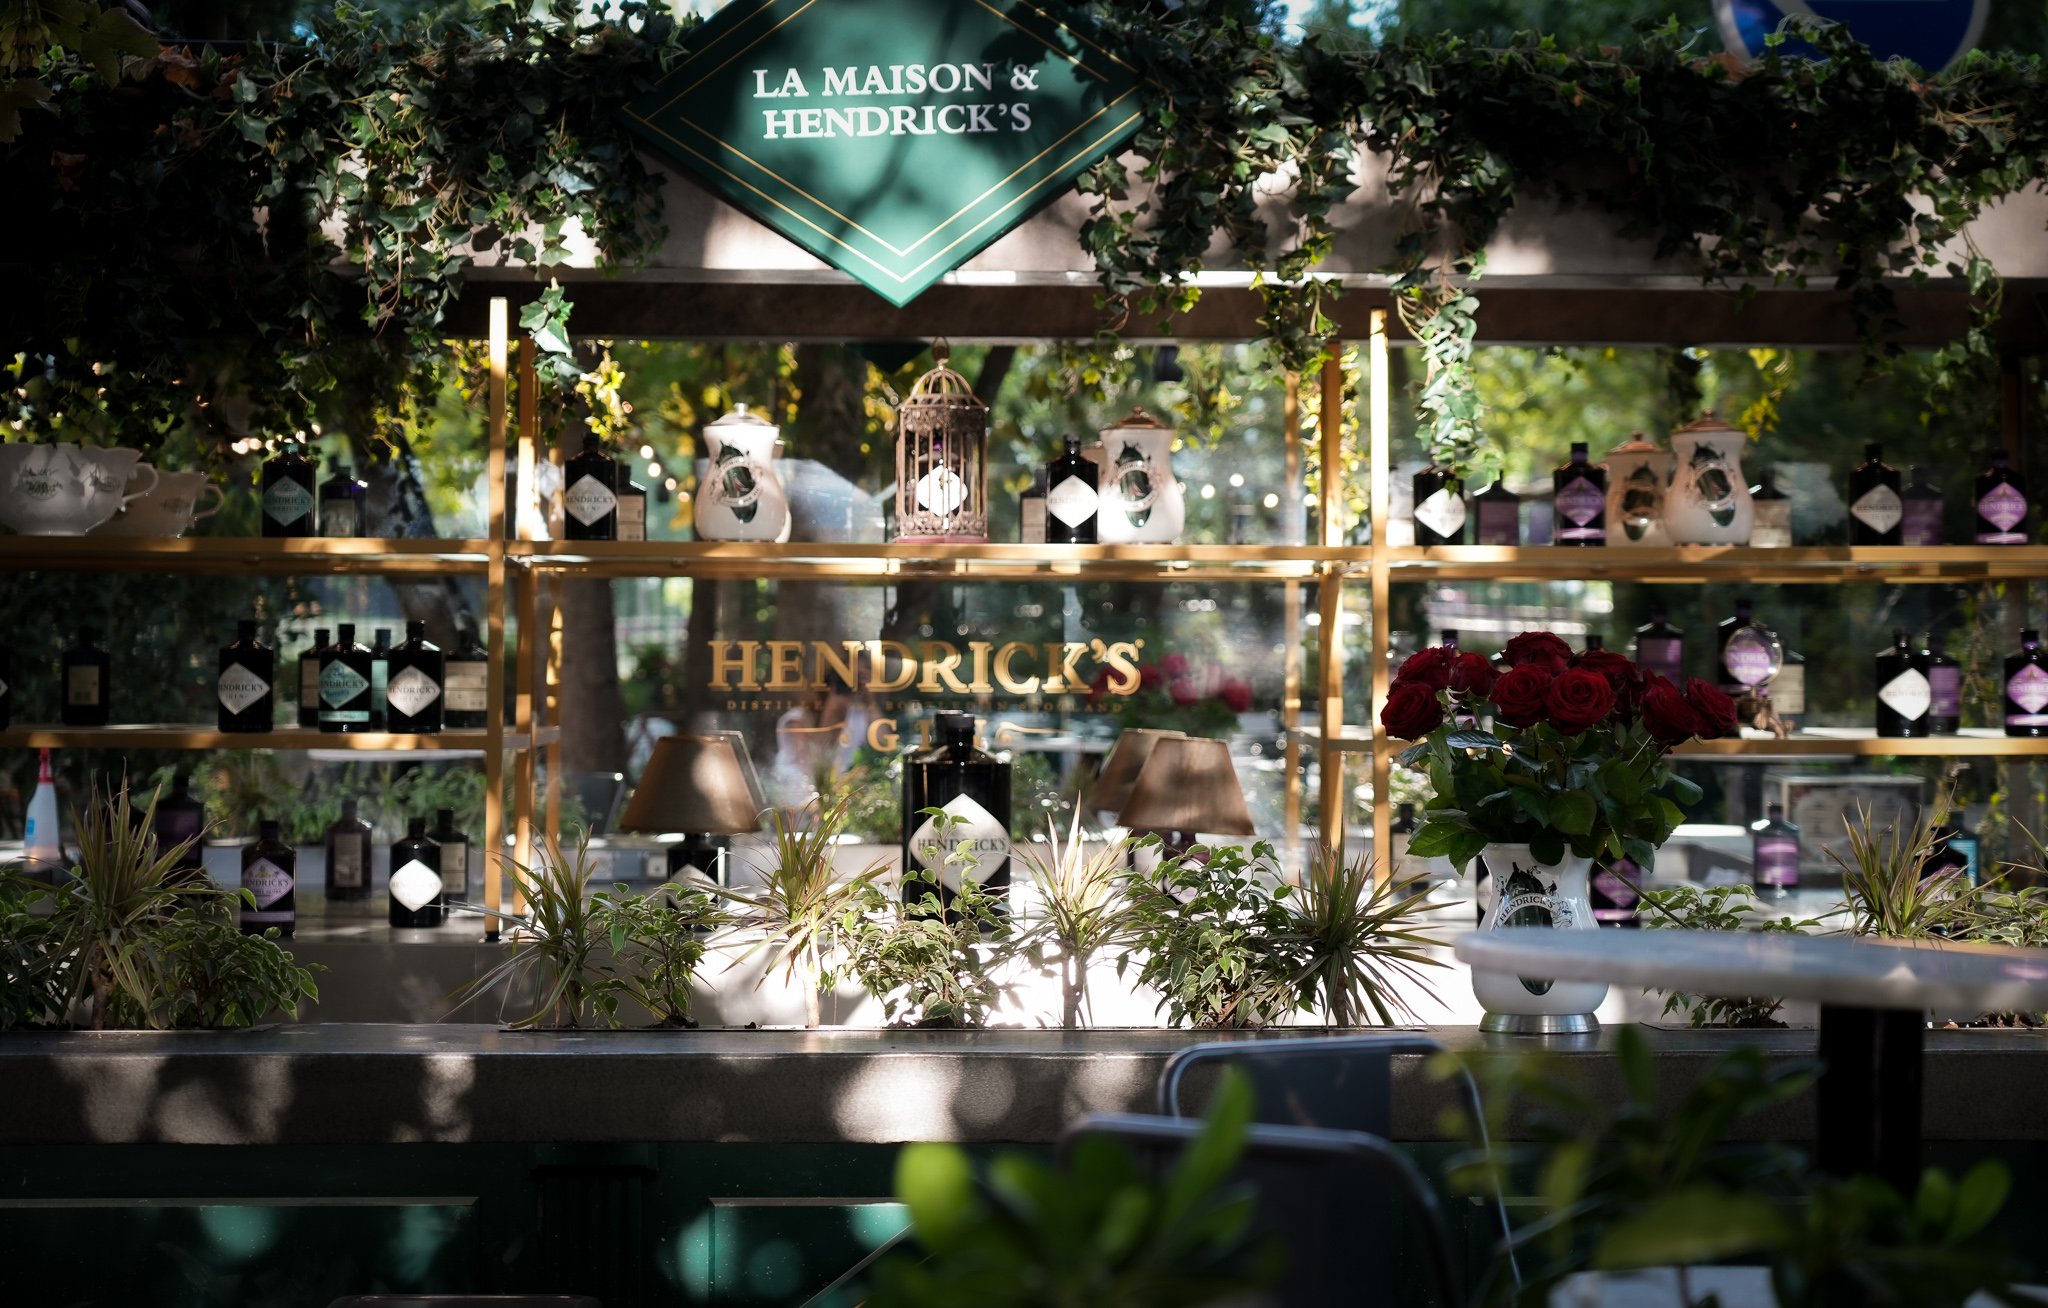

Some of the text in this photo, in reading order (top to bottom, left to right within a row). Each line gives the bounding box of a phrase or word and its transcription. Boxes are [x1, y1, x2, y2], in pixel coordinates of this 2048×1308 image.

[753, 63, 1040, 98] LA MAISON &
[763, 102, 1032, 139] HENDRICK'S
[707, 638, 1141, 696] HENDRICK'S
[917, 837, 1007, 851] HENDICK'S
[242, 879, 290, 887] ENDRICK'S
